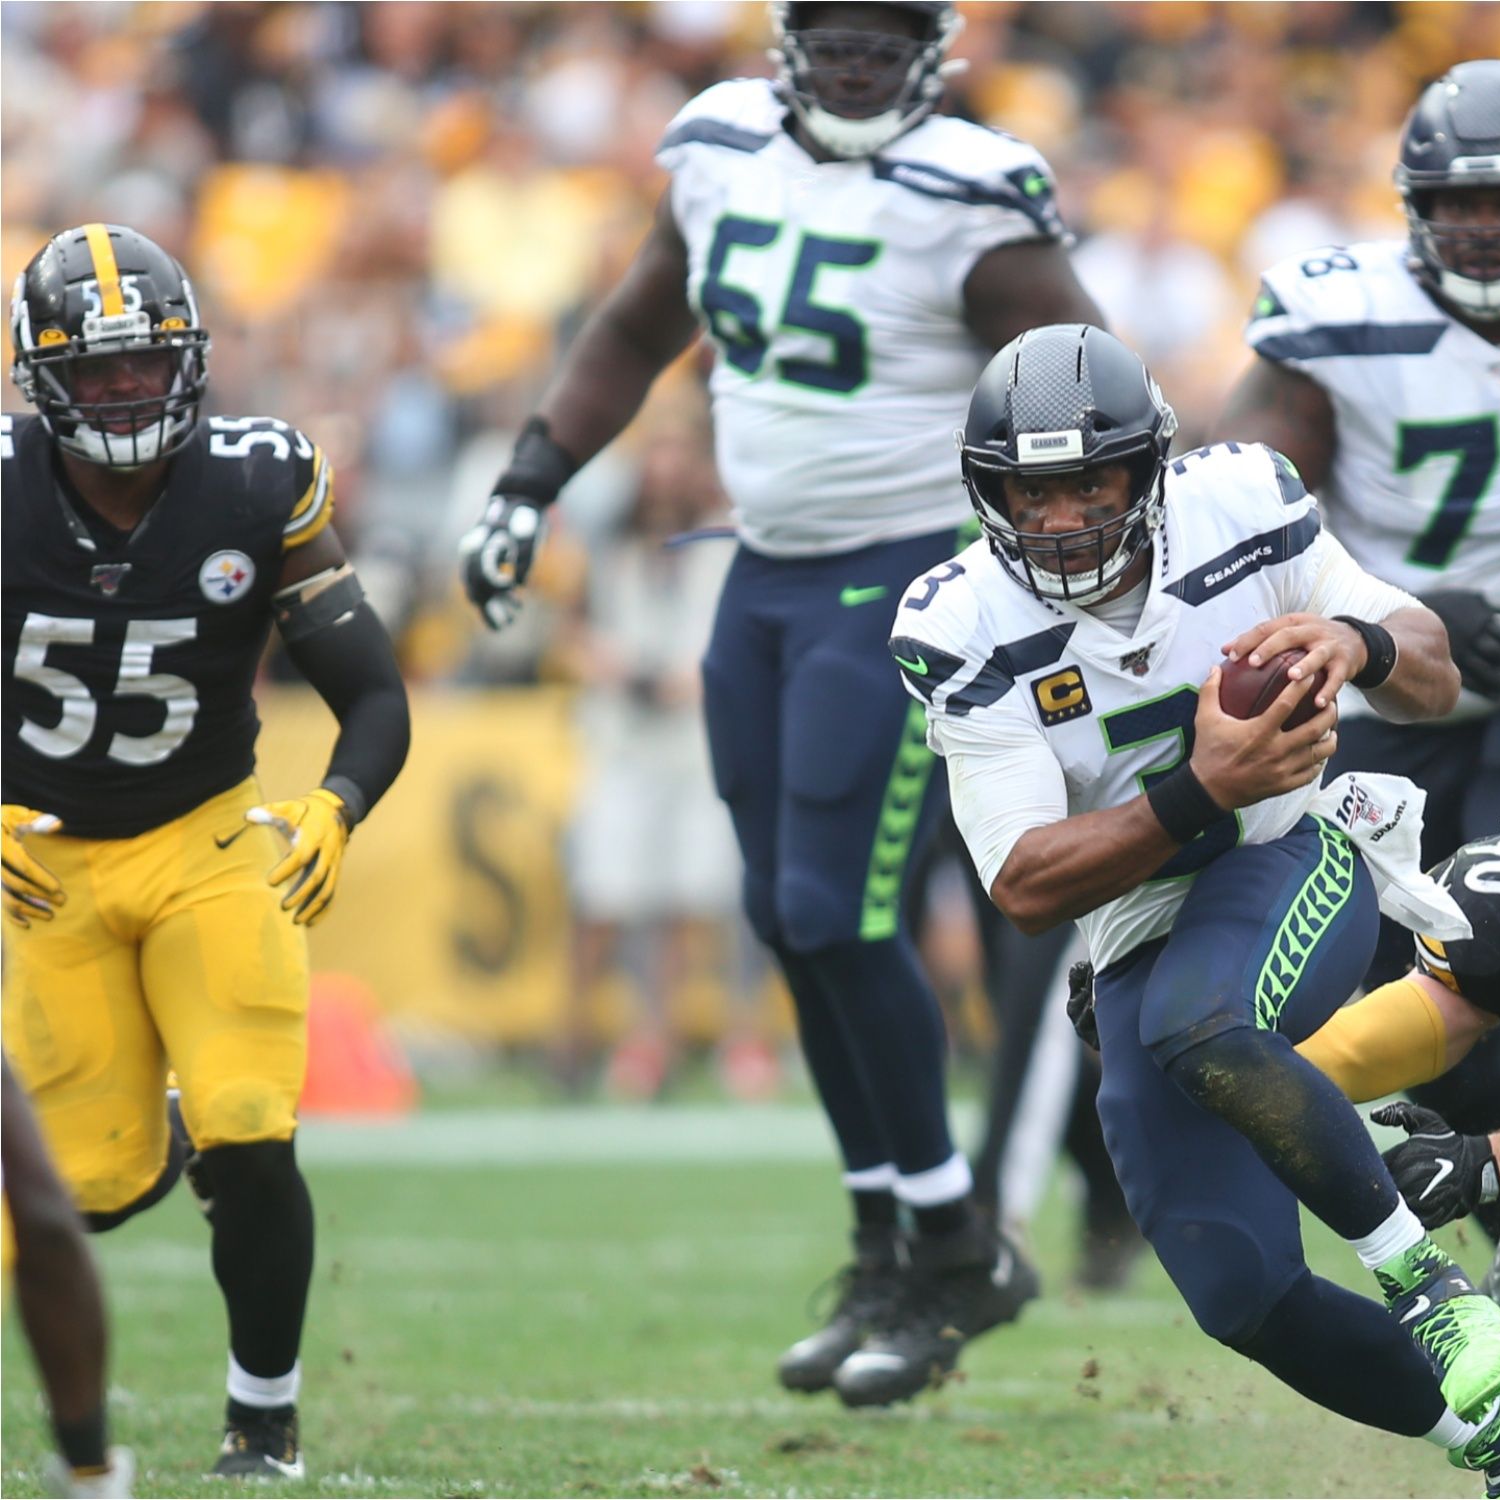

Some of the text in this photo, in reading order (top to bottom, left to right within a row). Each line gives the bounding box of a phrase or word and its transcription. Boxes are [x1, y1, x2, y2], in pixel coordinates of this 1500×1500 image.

[82, 275, 142, 318] 55
[700, 214, 884, 399] 65
[1203, 545, 1273, 588] SEAHAWKS
[13, 612, 199, 766] 55
[1037, 671, 1084, 712] C
